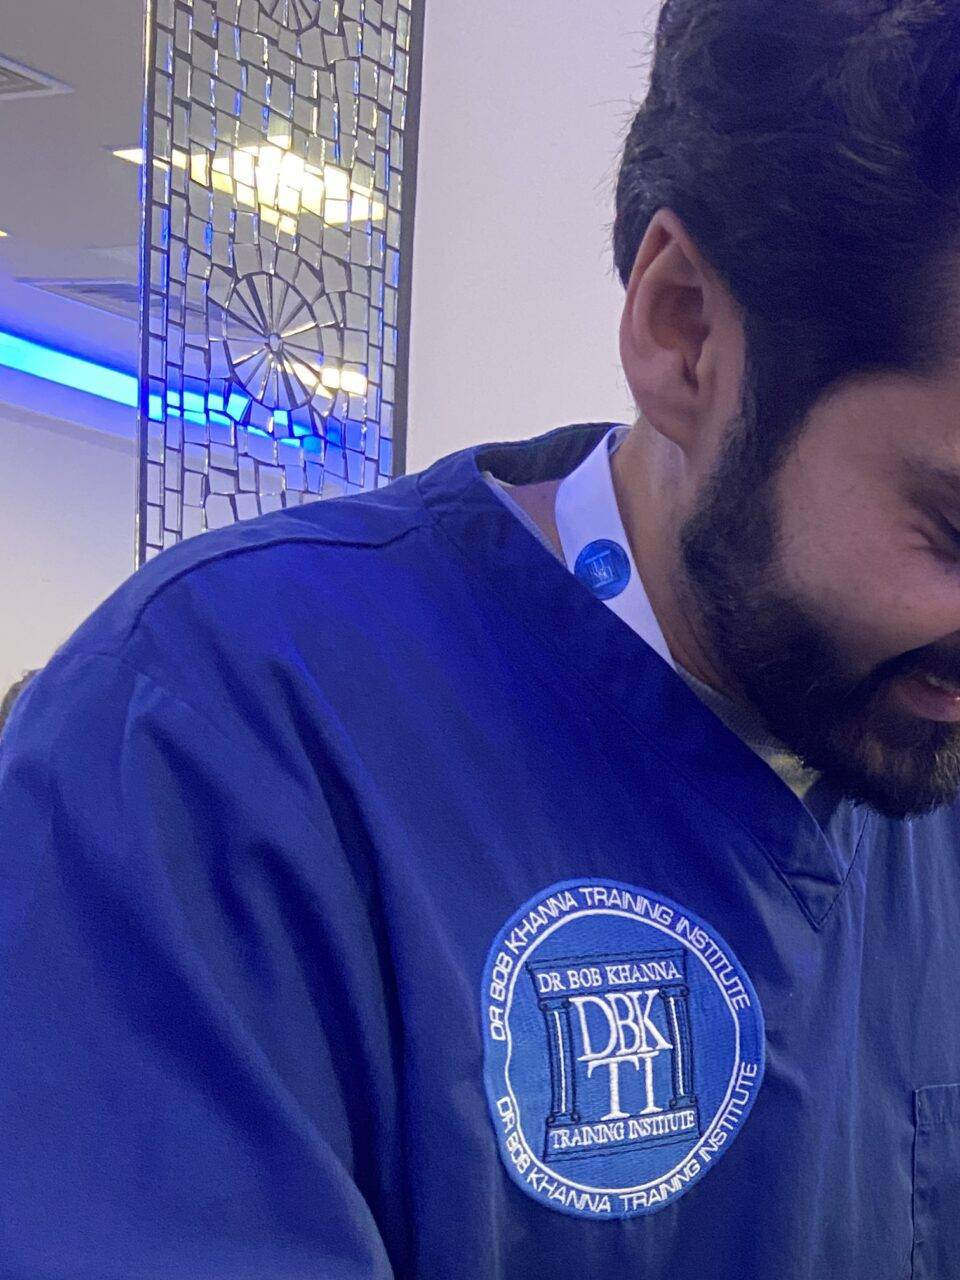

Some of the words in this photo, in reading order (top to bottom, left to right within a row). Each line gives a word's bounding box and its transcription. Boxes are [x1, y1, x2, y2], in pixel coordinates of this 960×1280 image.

[505, 891, 578, 955] KHANNA
[579, 886, 673, 925] TRAINING
[490, 951, 514, 1002] BOB
[538, 973, 565, 993] DR
[567, 967, 602, 989] BOB
[605, 960, 682, 986] KHANNA
[675, 916, 751, 1011] INSTITUTE
[490, 1004, 505, 1041] DR
[568, 988, 674, 1061] DBK
[587, 1050, 664, 1121] TI
[495, 1095, 516, 1134] DR
[550, 1122, 625, 1149] TRAINING
[628, 1109, 696, 1140] INSTITUTE
[697, 1061, 758, 1163] INSTITUTE
[504, 1133, 531, 1175] BOB
[526, 1167, 611, 1213] KHANNA
[618, 1157, 701, 1212] TRAINING
